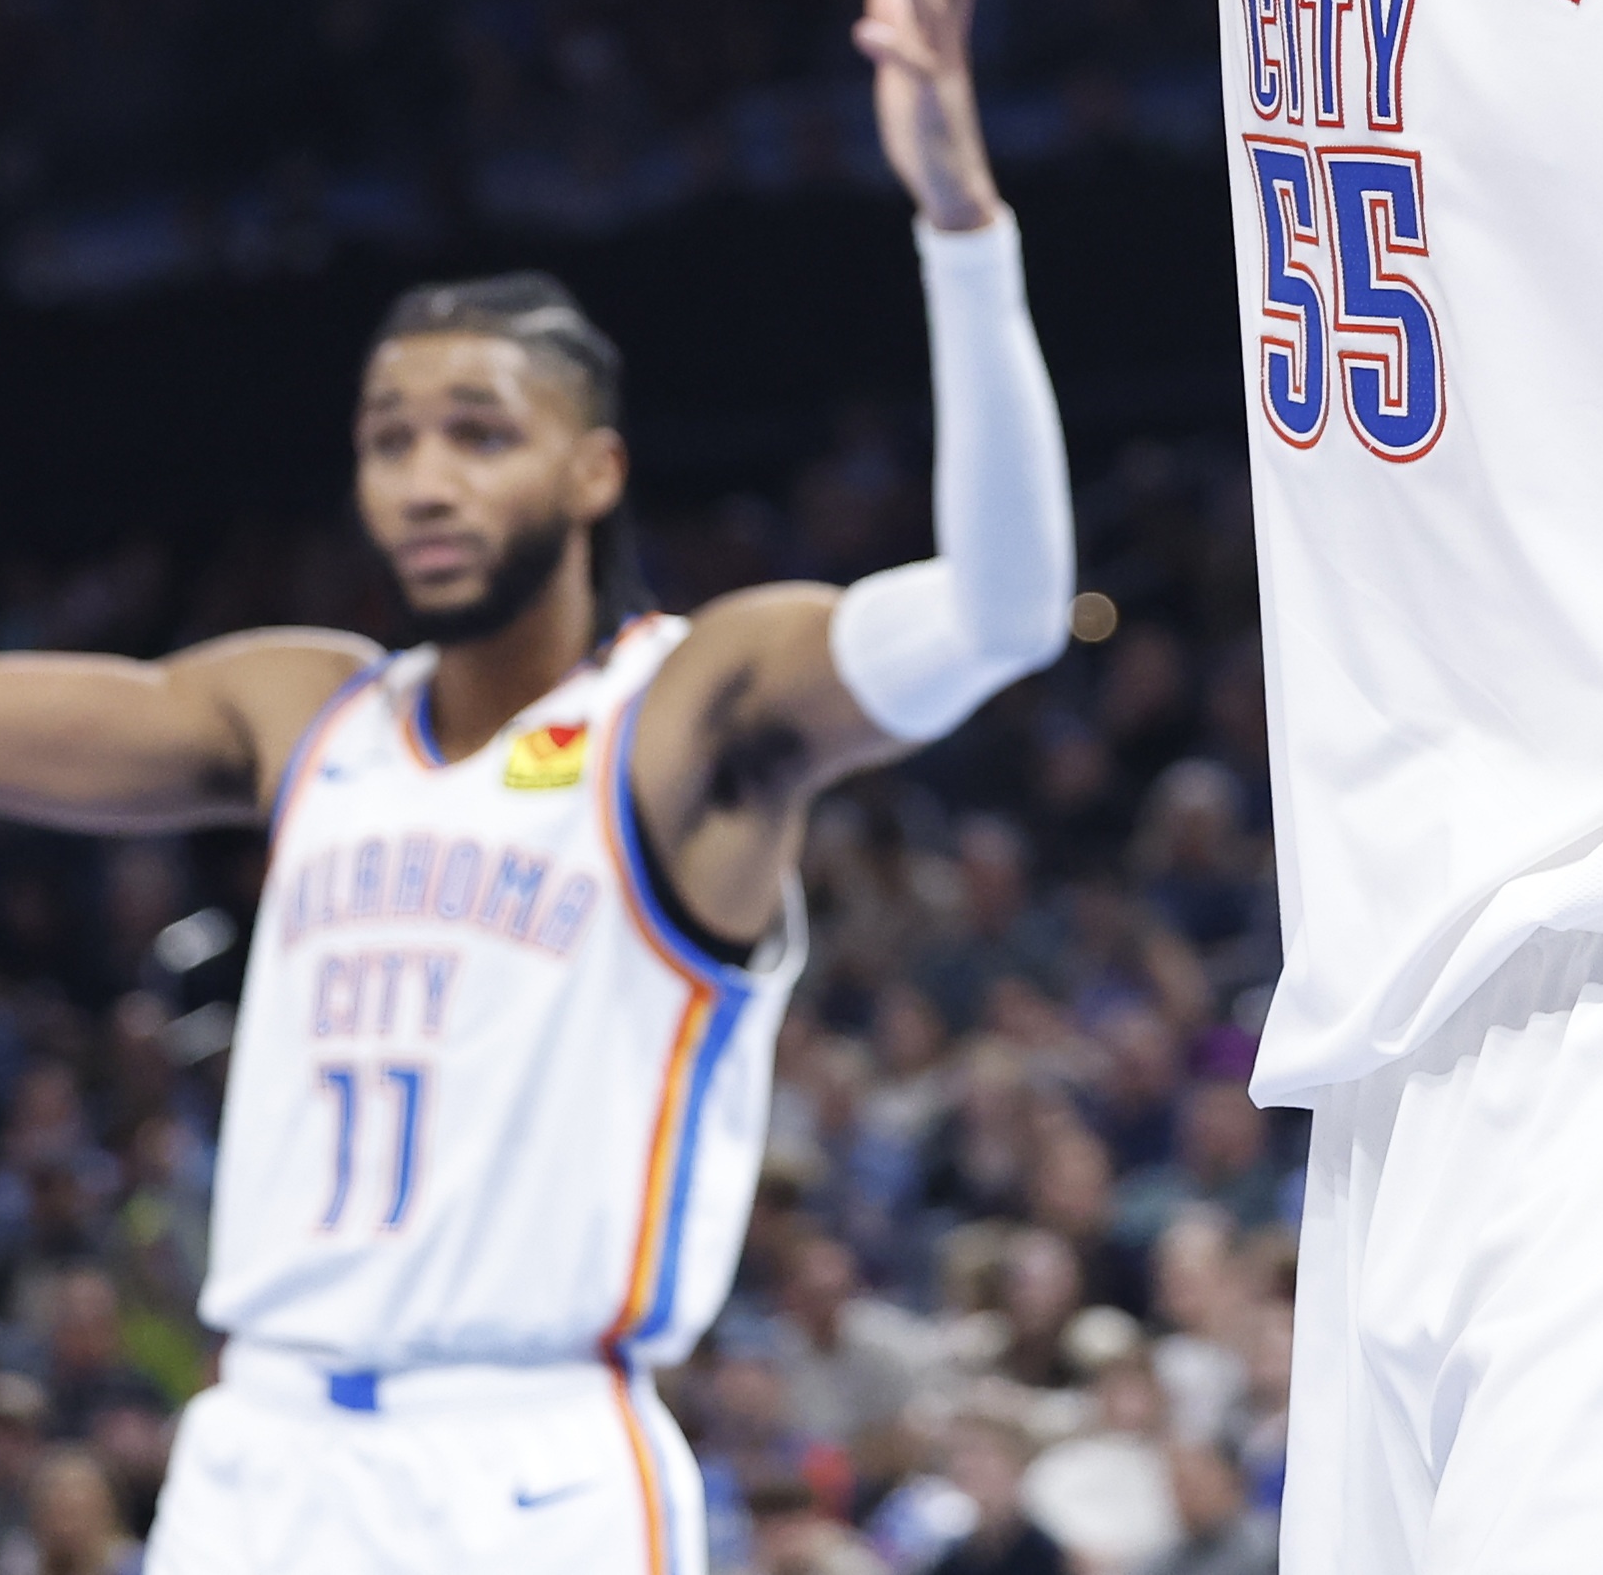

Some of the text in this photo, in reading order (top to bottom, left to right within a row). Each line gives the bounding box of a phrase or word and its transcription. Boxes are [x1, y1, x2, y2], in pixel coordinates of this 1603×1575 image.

[1242, 133, 1447, 464] 55
[306, 946, 461, 1039] CITY
[311, 1058, 435, 1238] 11
